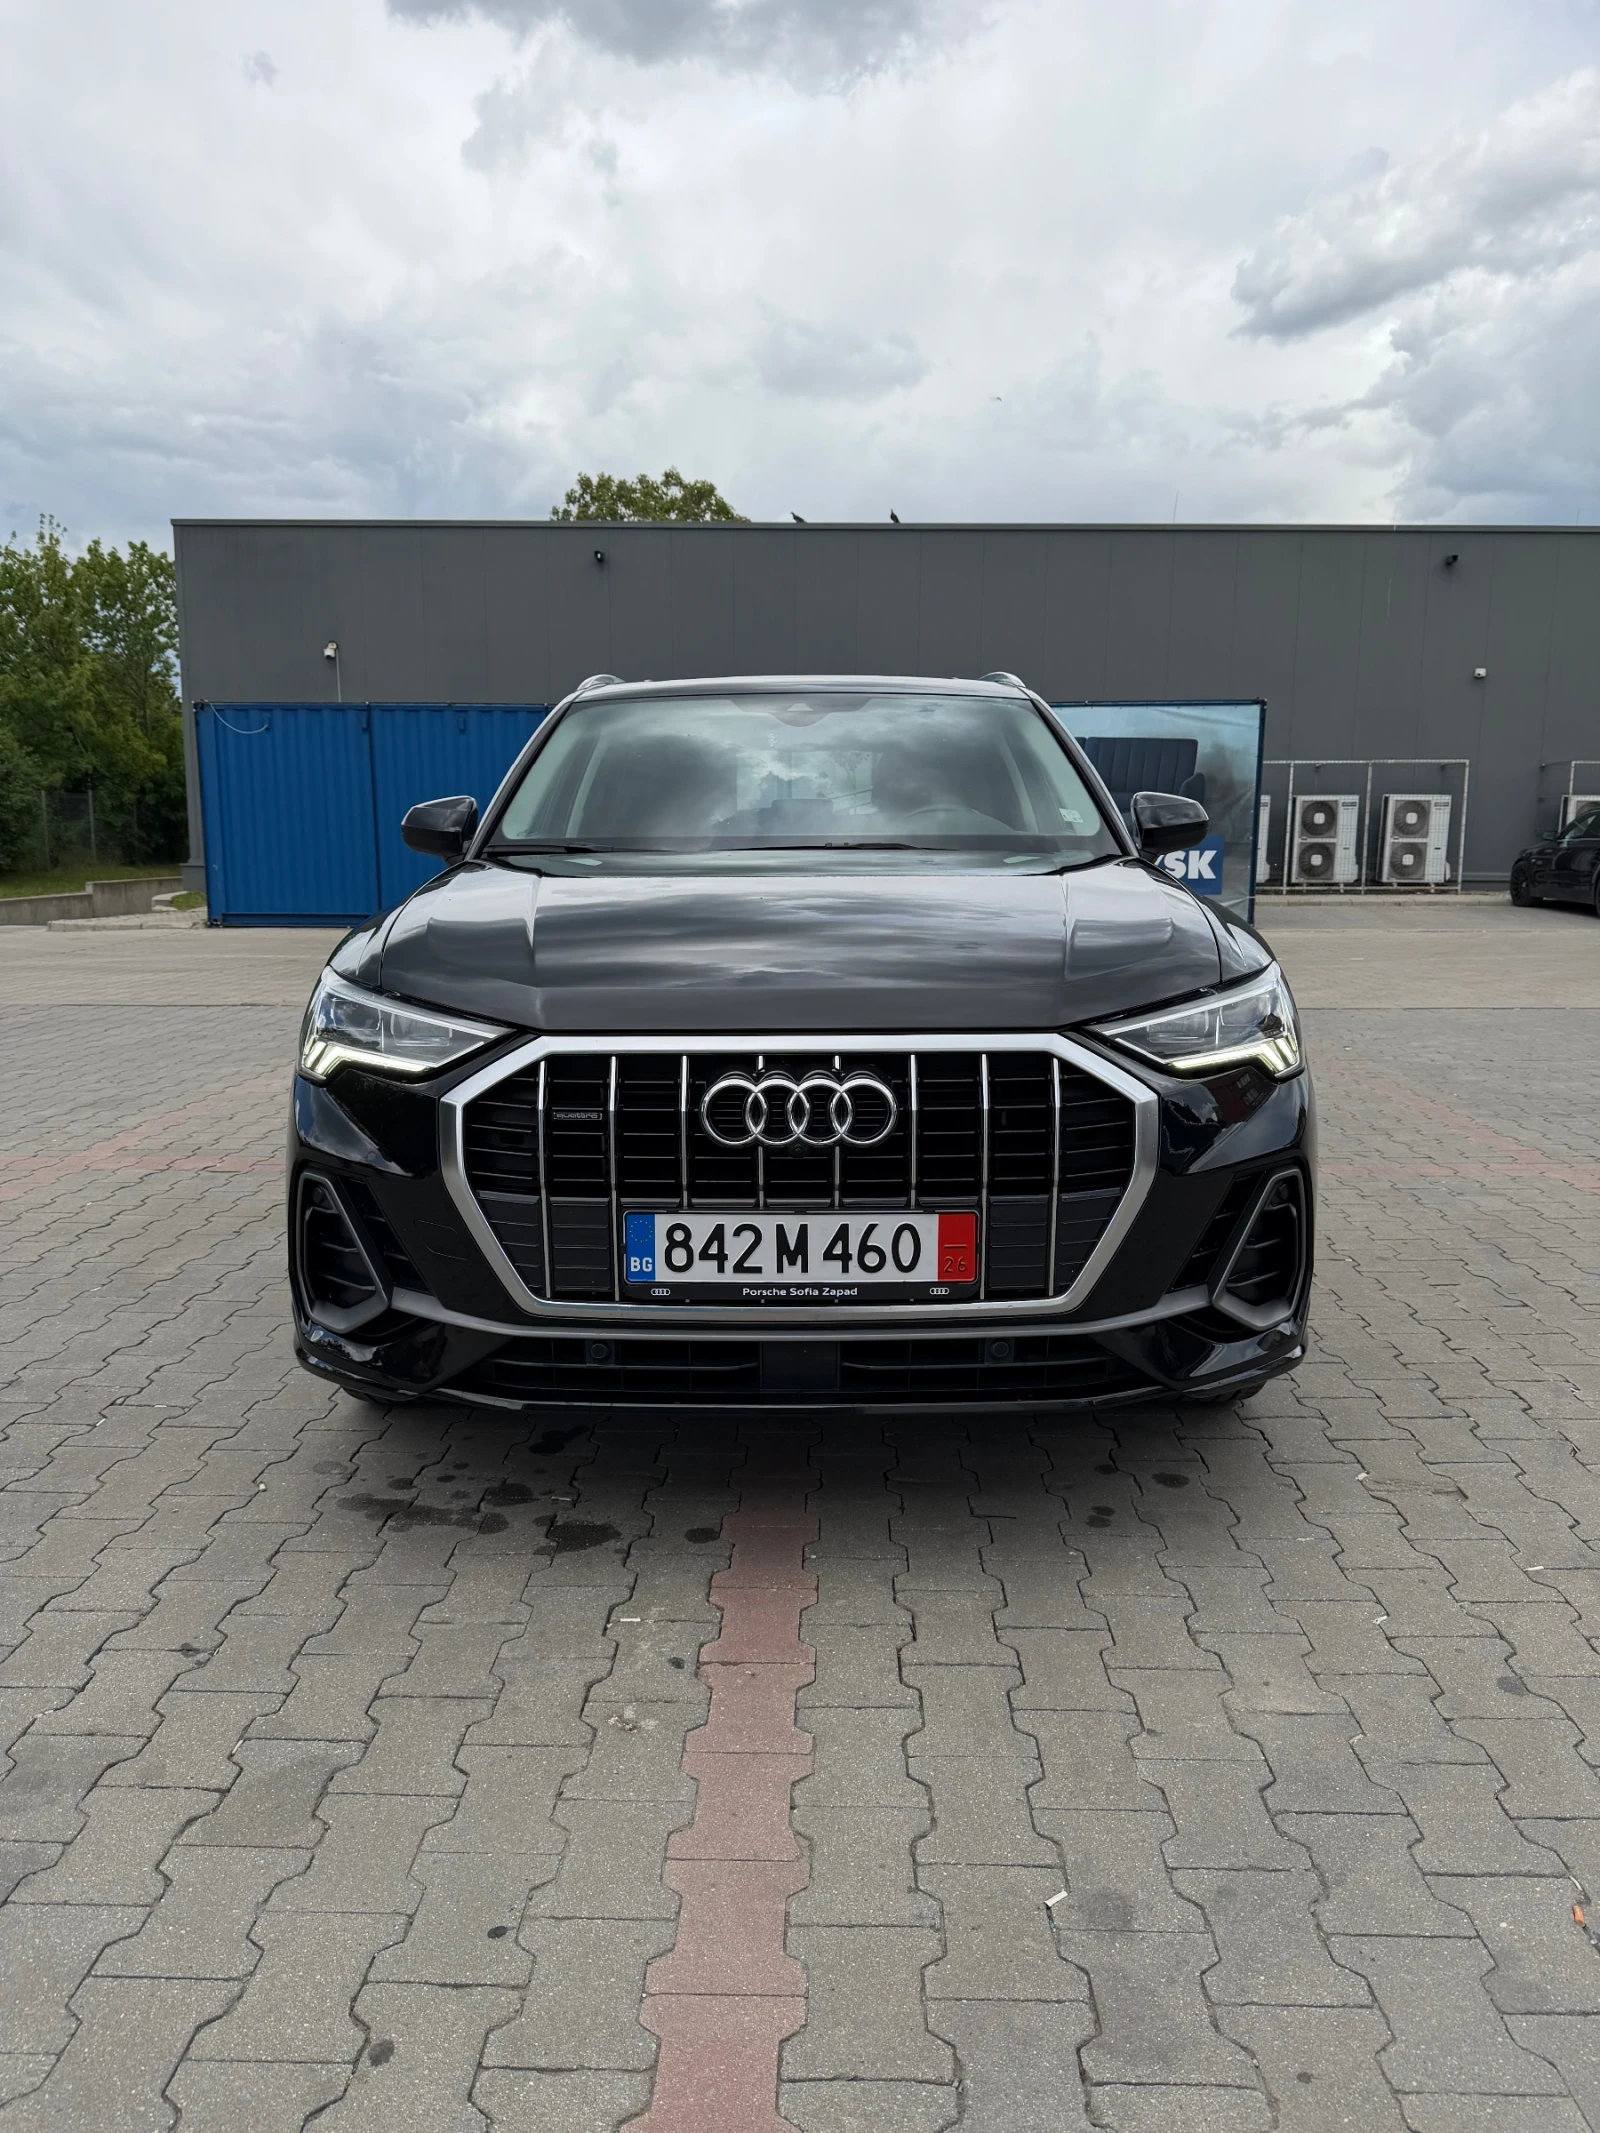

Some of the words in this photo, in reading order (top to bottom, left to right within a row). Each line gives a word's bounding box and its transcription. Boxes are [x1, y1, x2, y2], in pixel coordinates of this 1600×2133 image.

[1154, 849, 1217, 880] SK
[664, 1222, 763, 1274] 842
[775, 1223, 809, 1274] M
[822, 1222, 922, 1274] 460
[630, 1256, 653, 1273] BG
[943, 1256, 967, 1273] 26
[742, 1287, 787, 1296] Porsche
[789, 1287, 819, 1296] Sofia
[822, 1287, 858, 1298] Zapad
